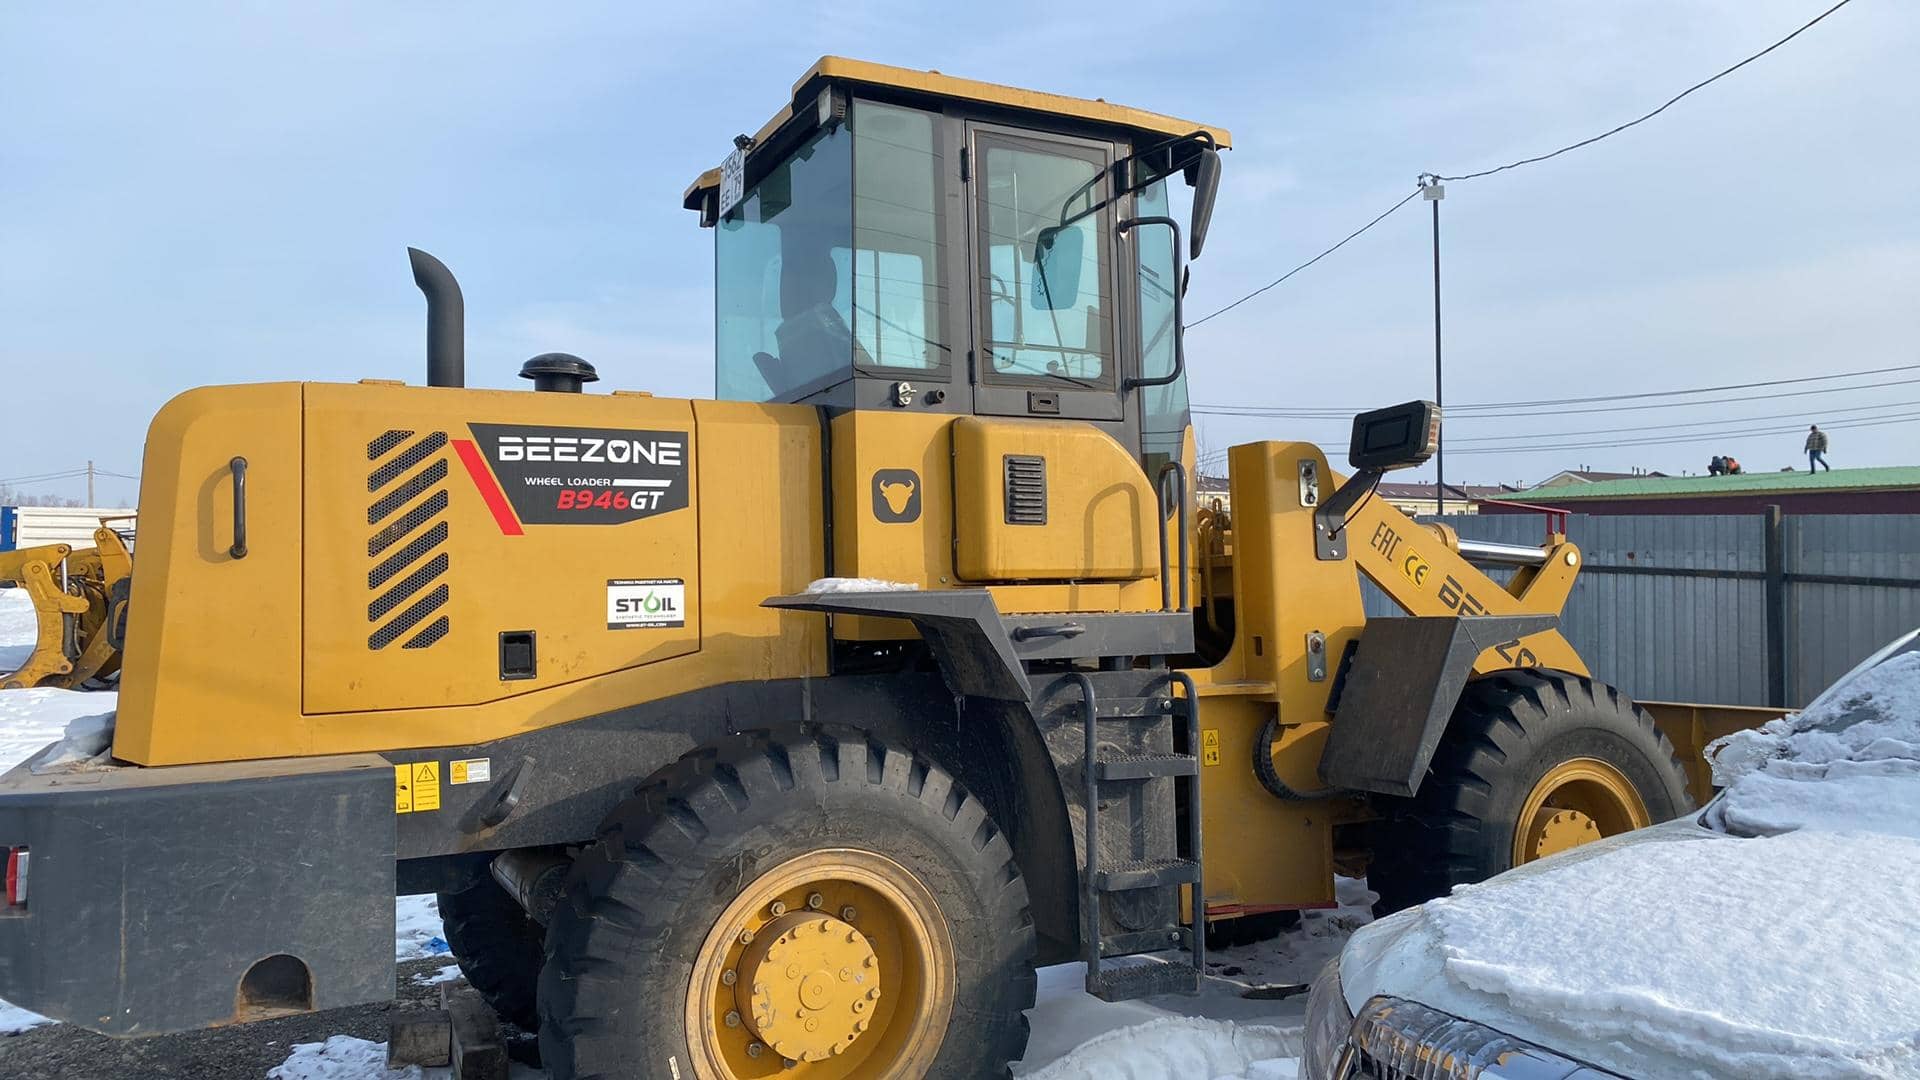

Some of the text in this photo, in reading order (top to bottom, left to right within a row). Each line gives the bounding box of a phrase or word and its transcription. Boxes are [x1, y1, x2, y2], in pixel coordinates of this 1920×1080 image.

[498, 436, 682, 466] BEEZONE
[524, 477, 611, 487] WHEEL LOADER
[557, 489, 664, 510] B946GT
[1404, 555, 1428, 586] CE
